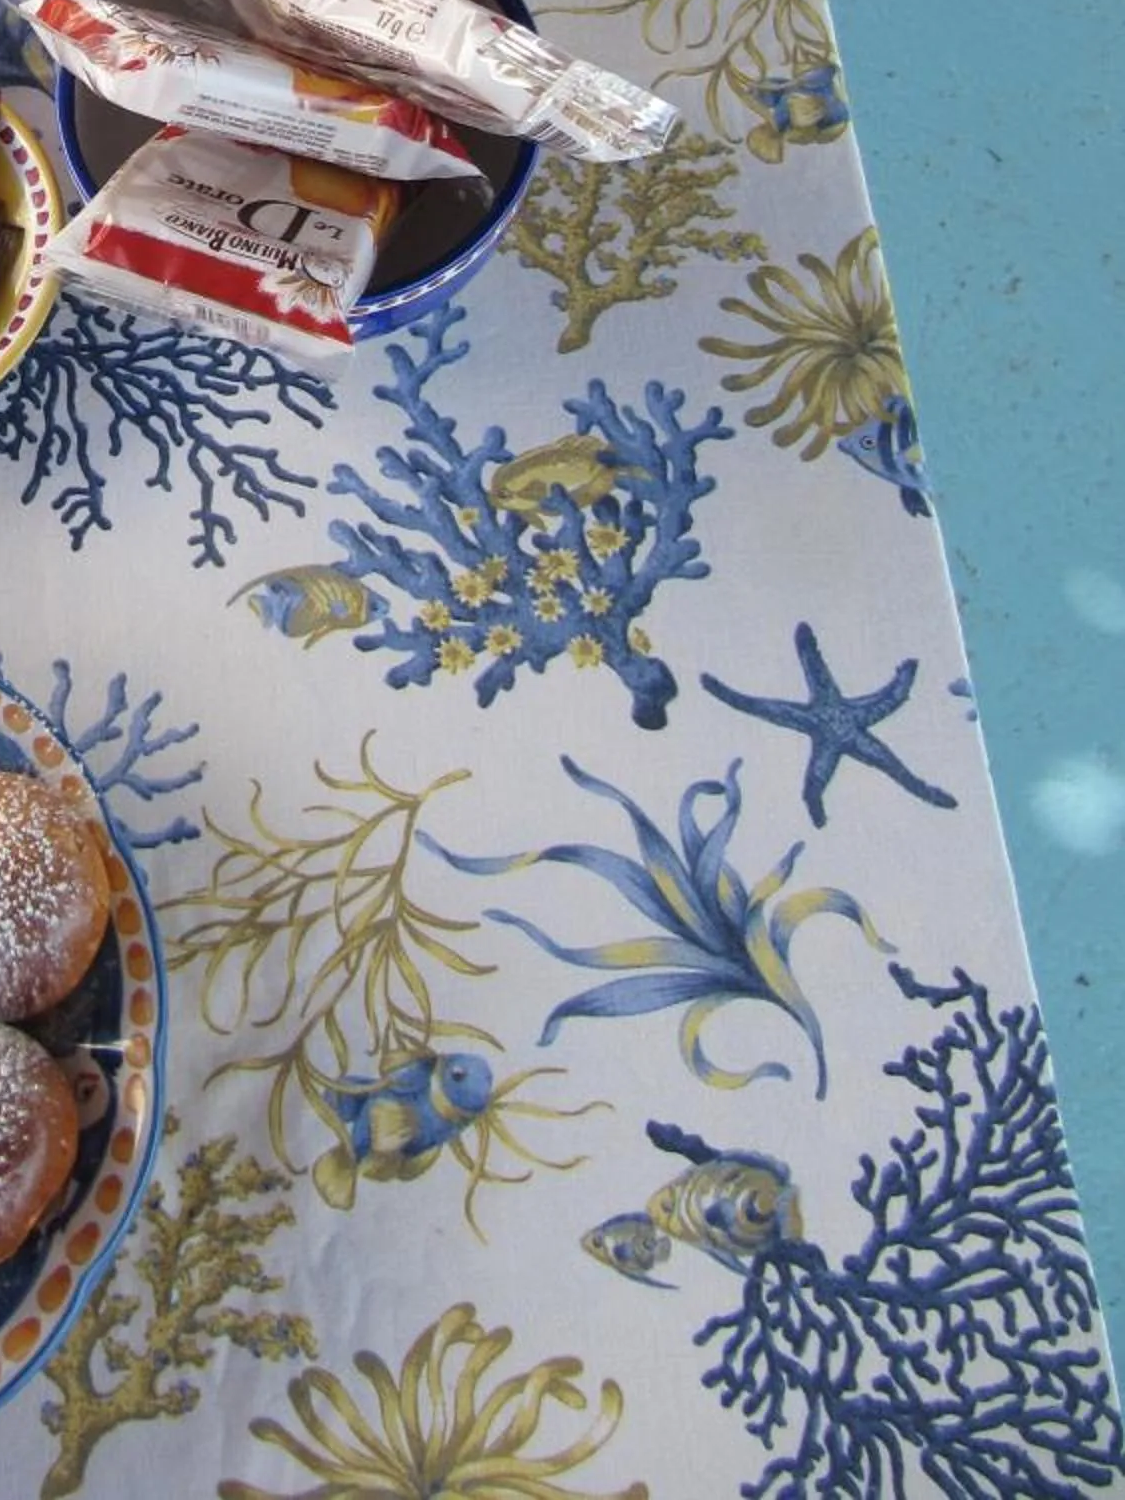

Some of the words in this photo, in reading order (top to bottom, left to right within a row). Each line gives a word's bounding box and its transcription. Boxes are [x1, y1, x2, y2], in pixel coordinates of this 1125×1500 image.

[167, 172, 321, 244] Dorate
[165, 212, 228, 252] BIANCO
[313, 220, 345, 240] Le
[228, 232, 300, 271] MULINO
